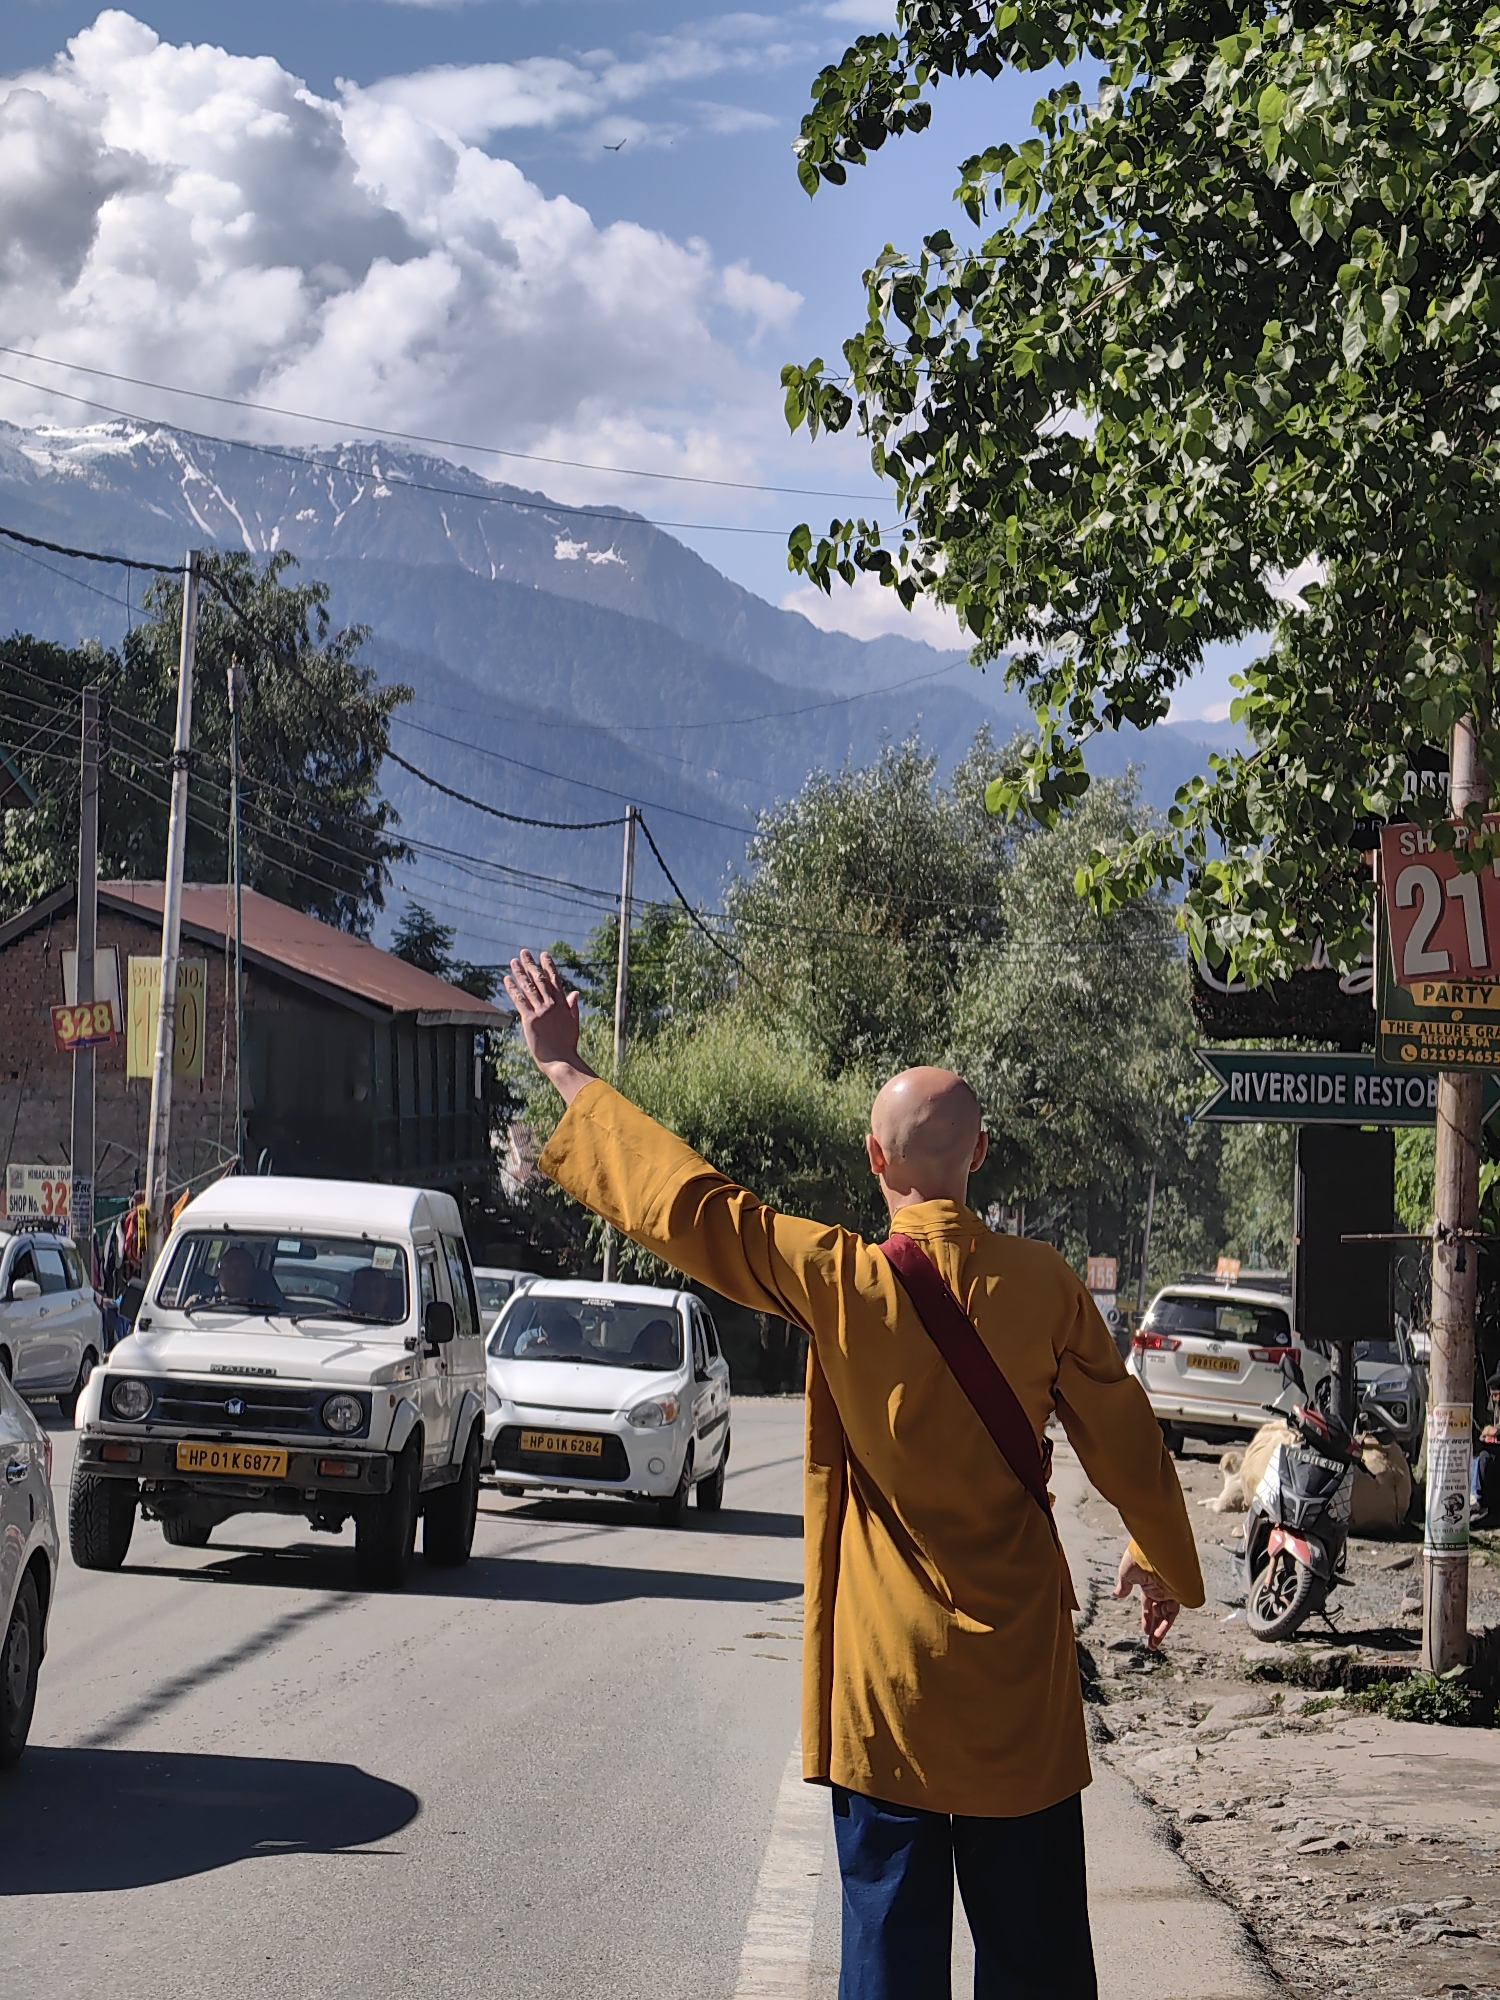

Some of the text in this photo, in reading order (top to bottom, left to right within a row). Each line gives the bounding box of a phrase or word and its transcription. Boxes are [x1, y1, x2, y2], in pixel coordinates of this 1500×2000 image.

[1400, 825, 1470, 856] SHP
[1395, 857, 1500, 976] 21
[133, 966, 162, 988] SHO
[1422, 984, 1493, 1005] PARTY
[55, 1003, 111, 1040] 328
[1387, 1021, 1415, 1034] THE
[1418, 1022, 1471, 1037] ALLURE
[1421, 1034, 1459, 1046] RESORT
[1471, 1037, 1491, 1048] SPA
[1230, 1071, 1346, 1105] RIVERSIDE
[27, 1169, 56, 1180] HIMACHAL
[9, 1194, 27, 1213] SHOP
[41, 1180, 72, 1216] 32
[188, 1449, 208, 1467] HP
[243, 1453, 281, 1473] 6877
